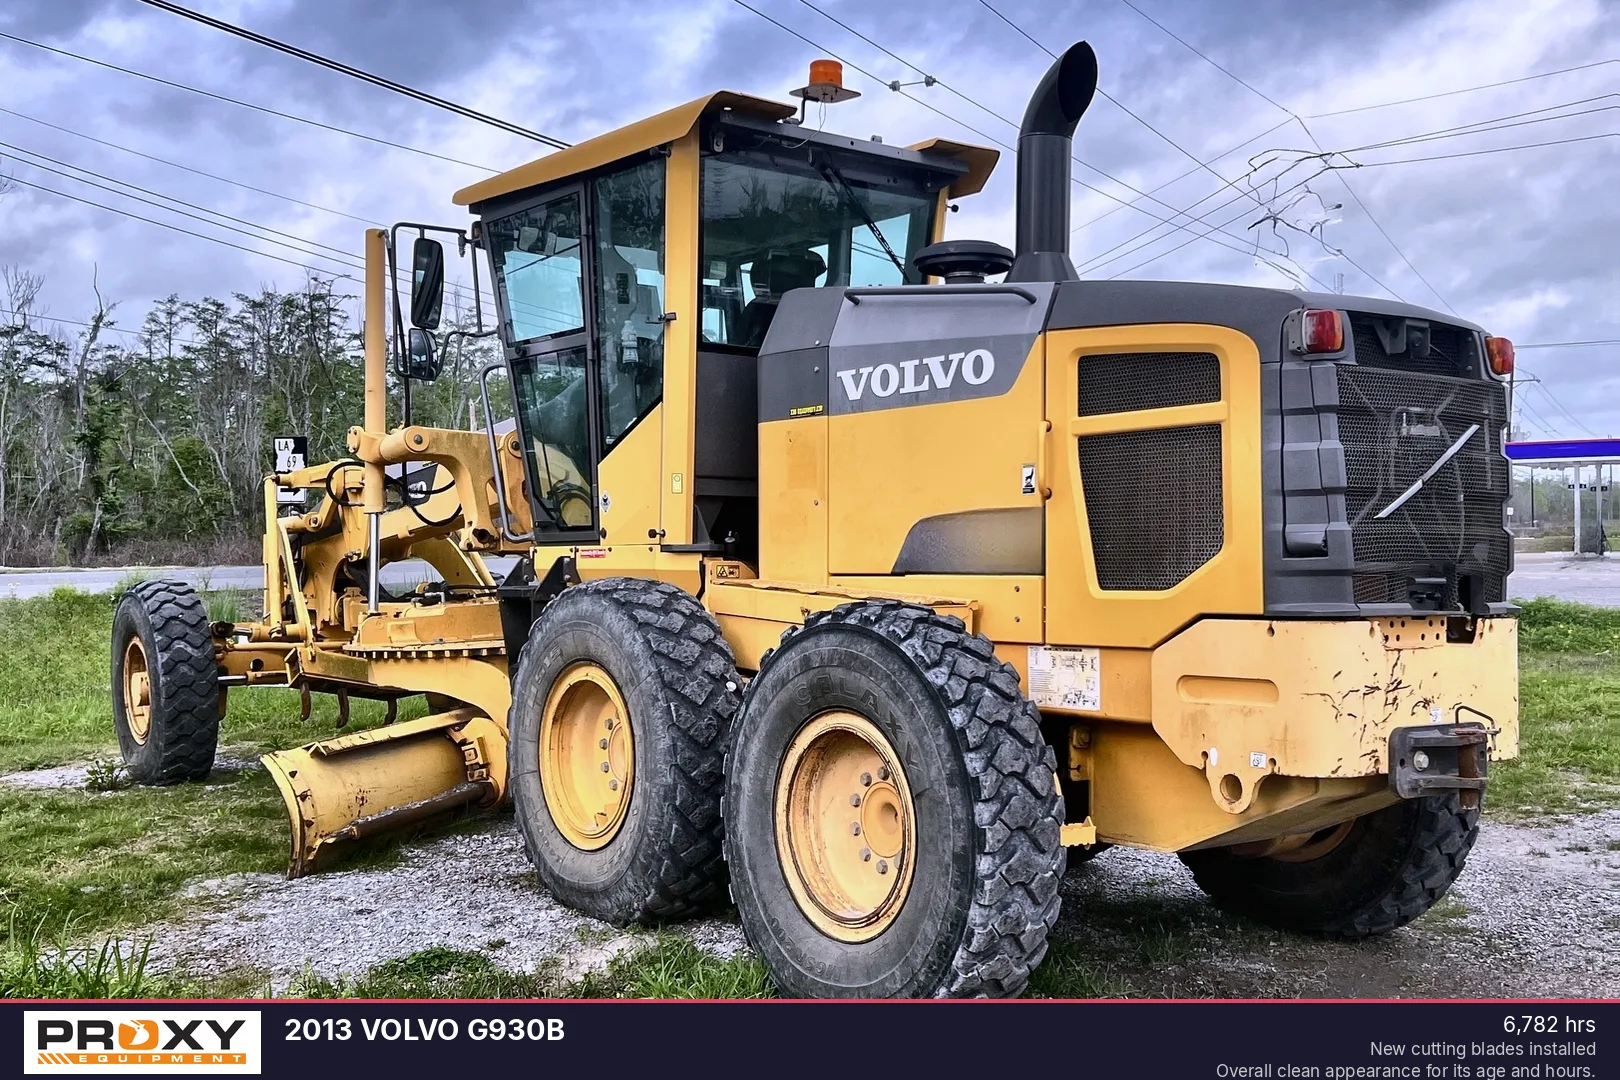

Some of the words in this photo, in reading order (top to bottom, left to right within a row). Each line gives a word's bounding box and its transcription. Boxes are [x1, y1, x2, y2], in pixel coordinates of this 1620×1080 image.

[836, 349, 994, 401] VOLVO
[278, 440, 290, 451] LA
[286, 455, 297, 468] 69
[792, 674, 924, 772] GALAXY
